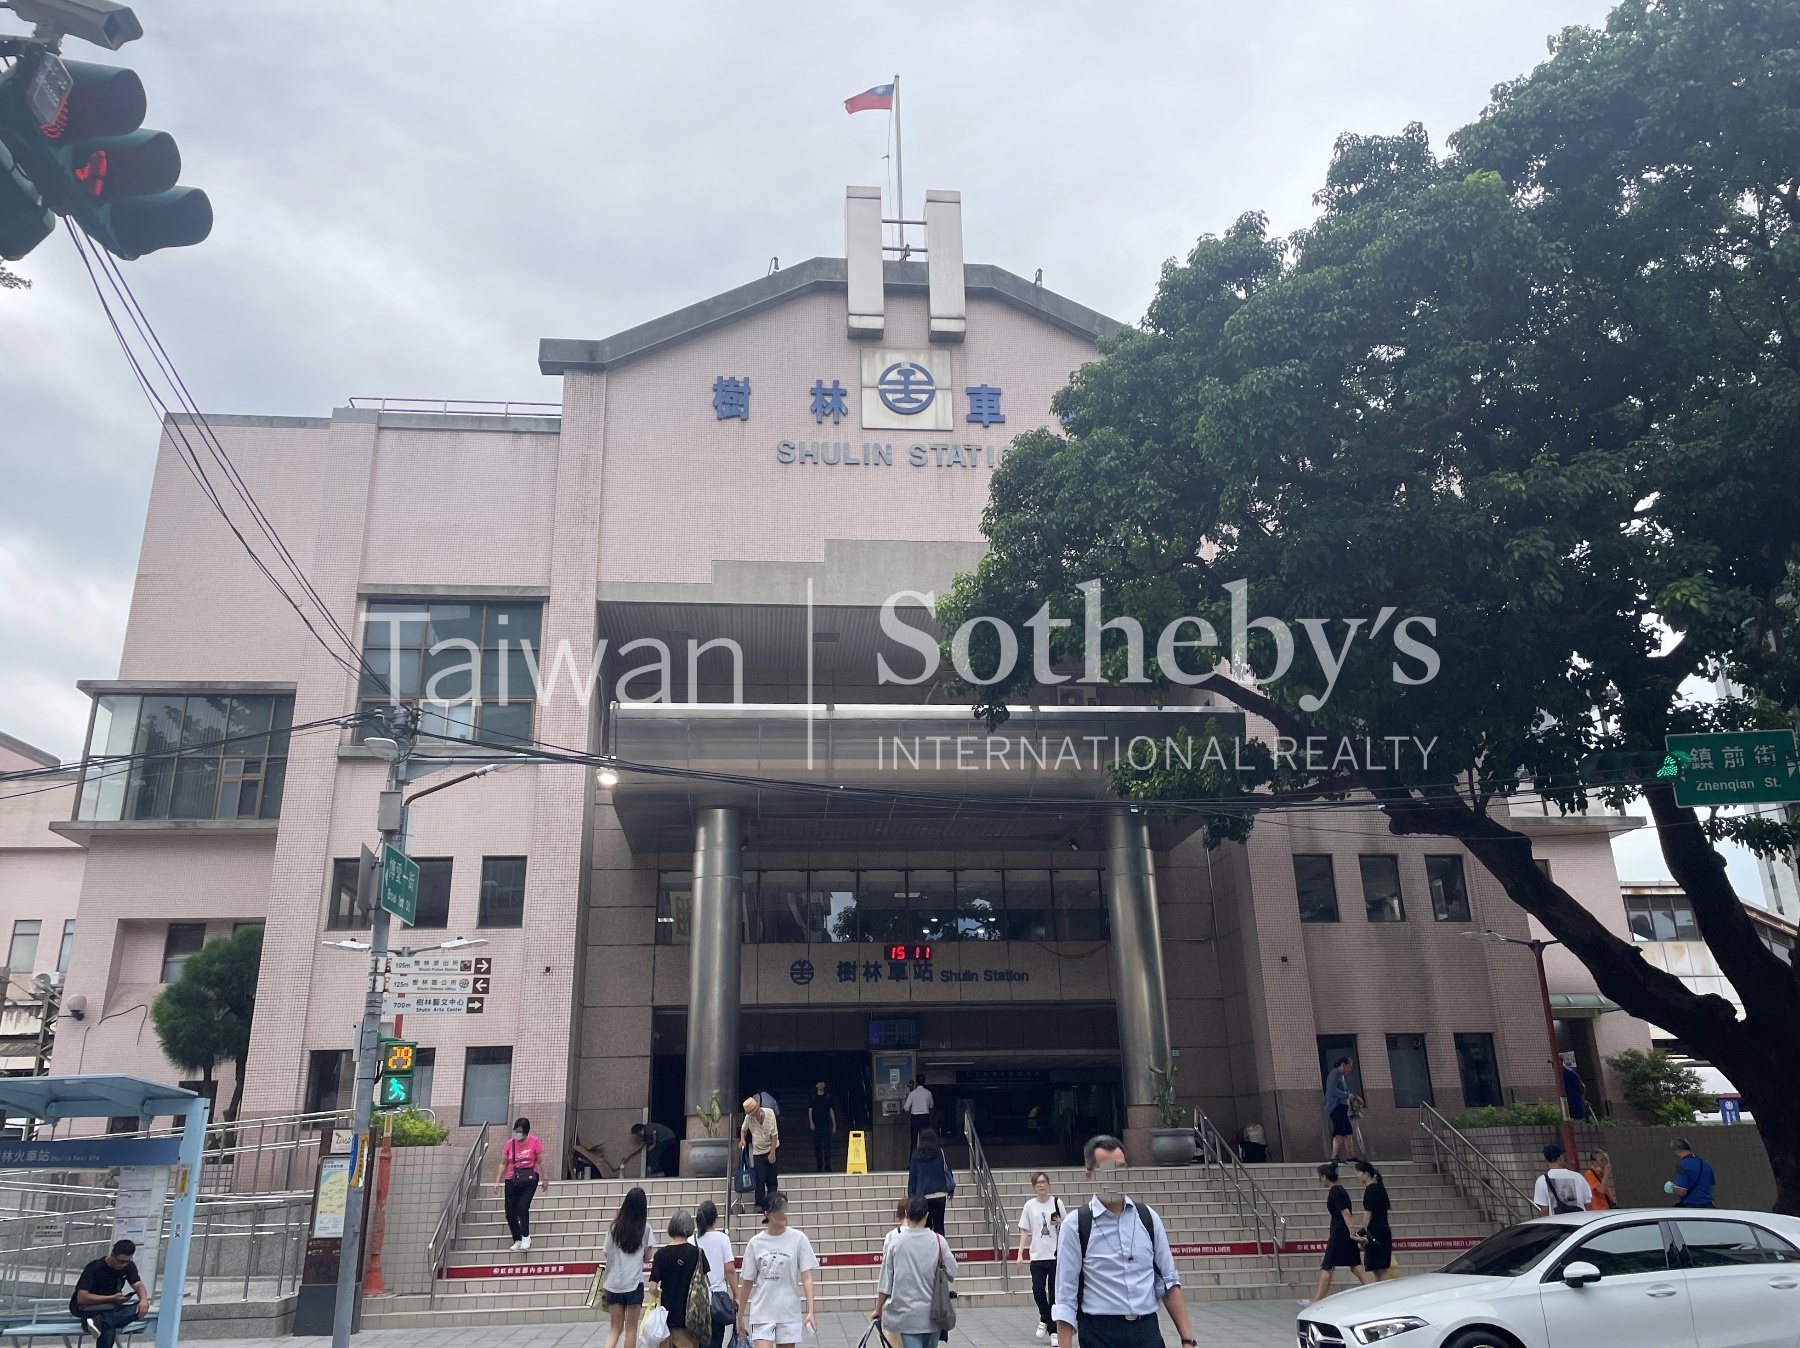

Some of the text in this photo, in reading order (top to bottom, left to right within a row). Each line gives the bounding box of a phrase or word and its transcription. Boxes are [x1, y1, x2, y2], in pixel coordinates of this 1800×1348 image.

[776, 440, 892, 466] SHULIN
[1689, 744, 1777, 770] 鎮前街
[1695, 777, 1782, 792] Zhenqian St.
[891, 945, 931, 960] 15 11
[836, 960, 934, 983] 樹林車站
[940, 969, 1030, 982] Shulin Station
[416, 998, 464, 1006] 樹林藝文中心
[388, 1046, 413, 1069] 29
[0, 1150, 51, 1163] 林火車站
